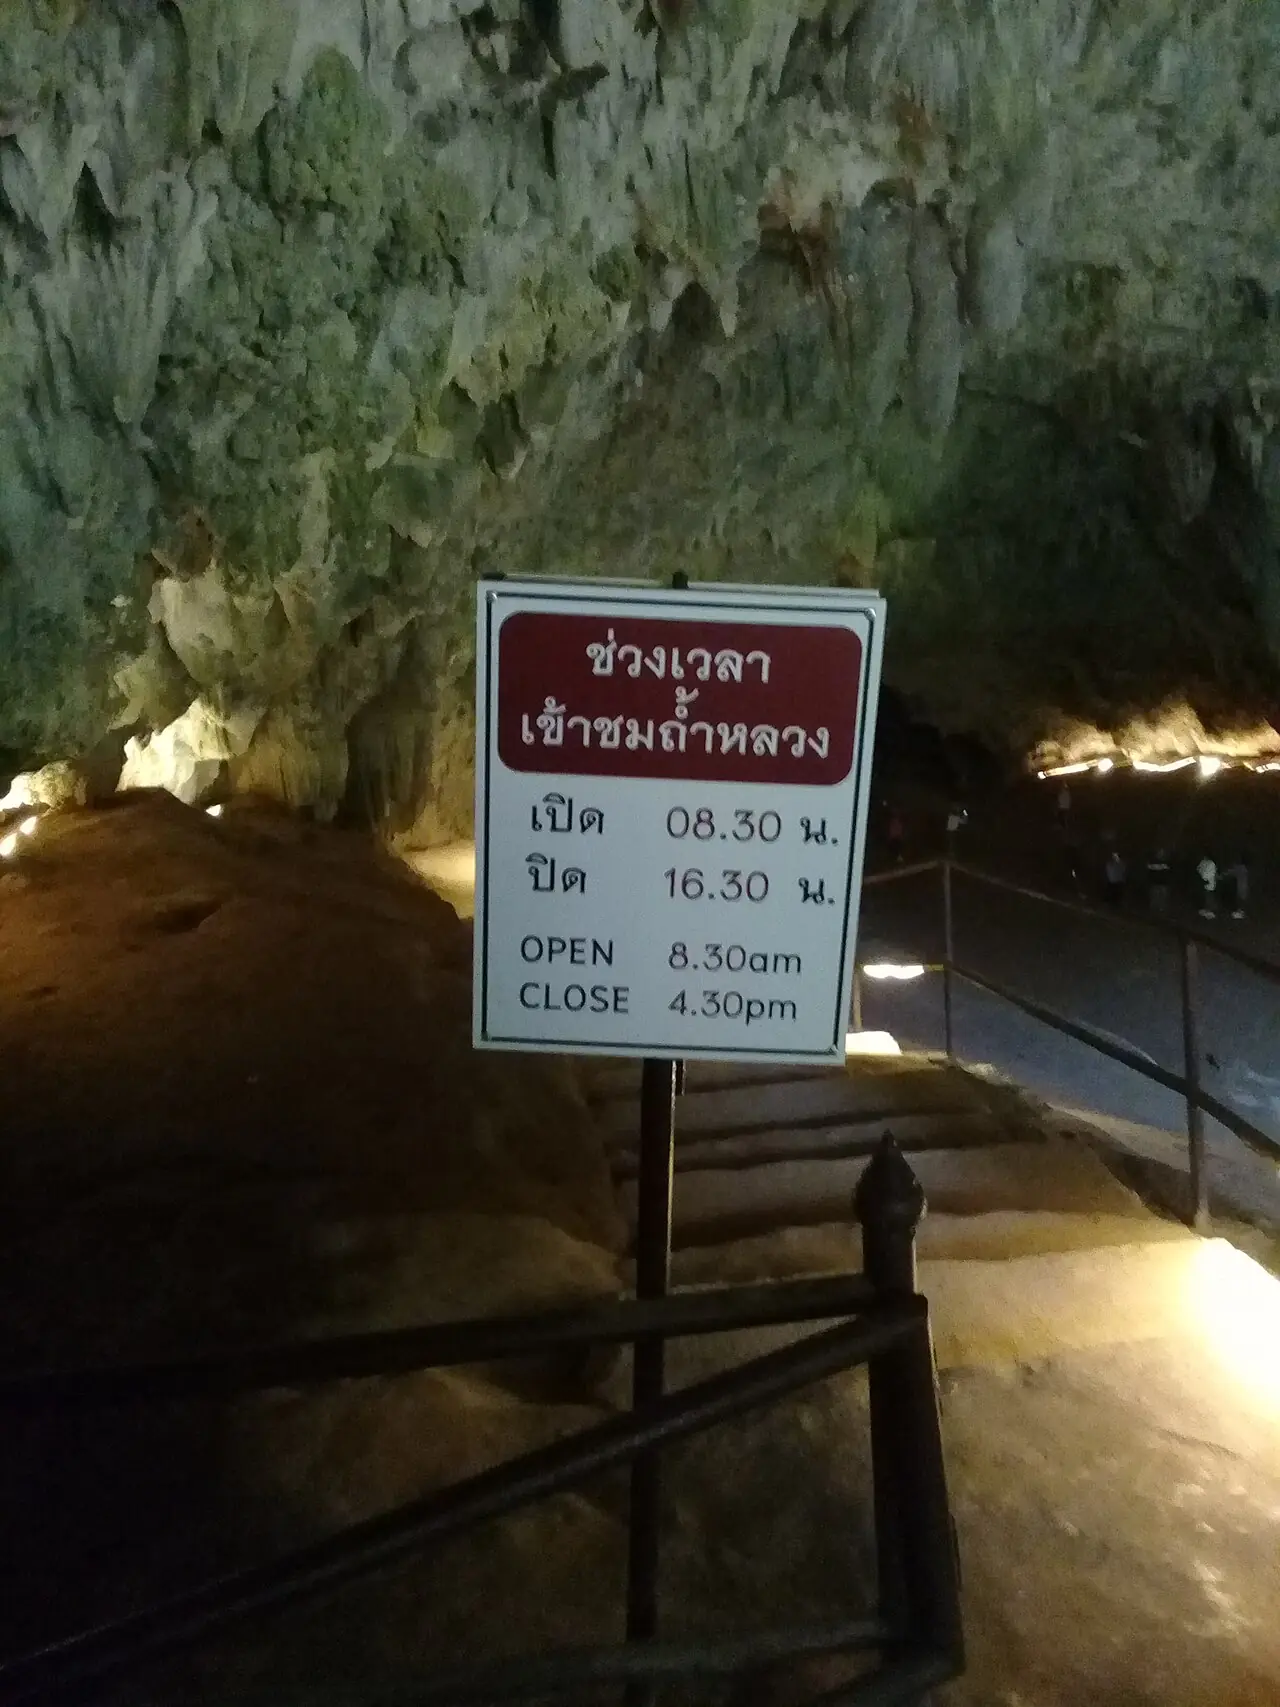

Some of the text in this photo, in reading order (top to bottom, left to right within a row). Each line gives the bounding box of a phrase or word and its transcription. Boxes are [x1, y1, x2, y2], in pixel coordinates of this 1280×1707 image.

[585, 628, 771, 683] ช่วงเวลา
[521, 686, 830, 759] เข้าชมถ้ำหลวง
[530, 792, 839, 846] เปิด 08.30 น.
[525, 853, 835, 905] ปิด 16.30 น.
[520, 935, 802, 975] OPEN 8.30am
[519, 982, 798, 1026] CLOSE 4.30pm
